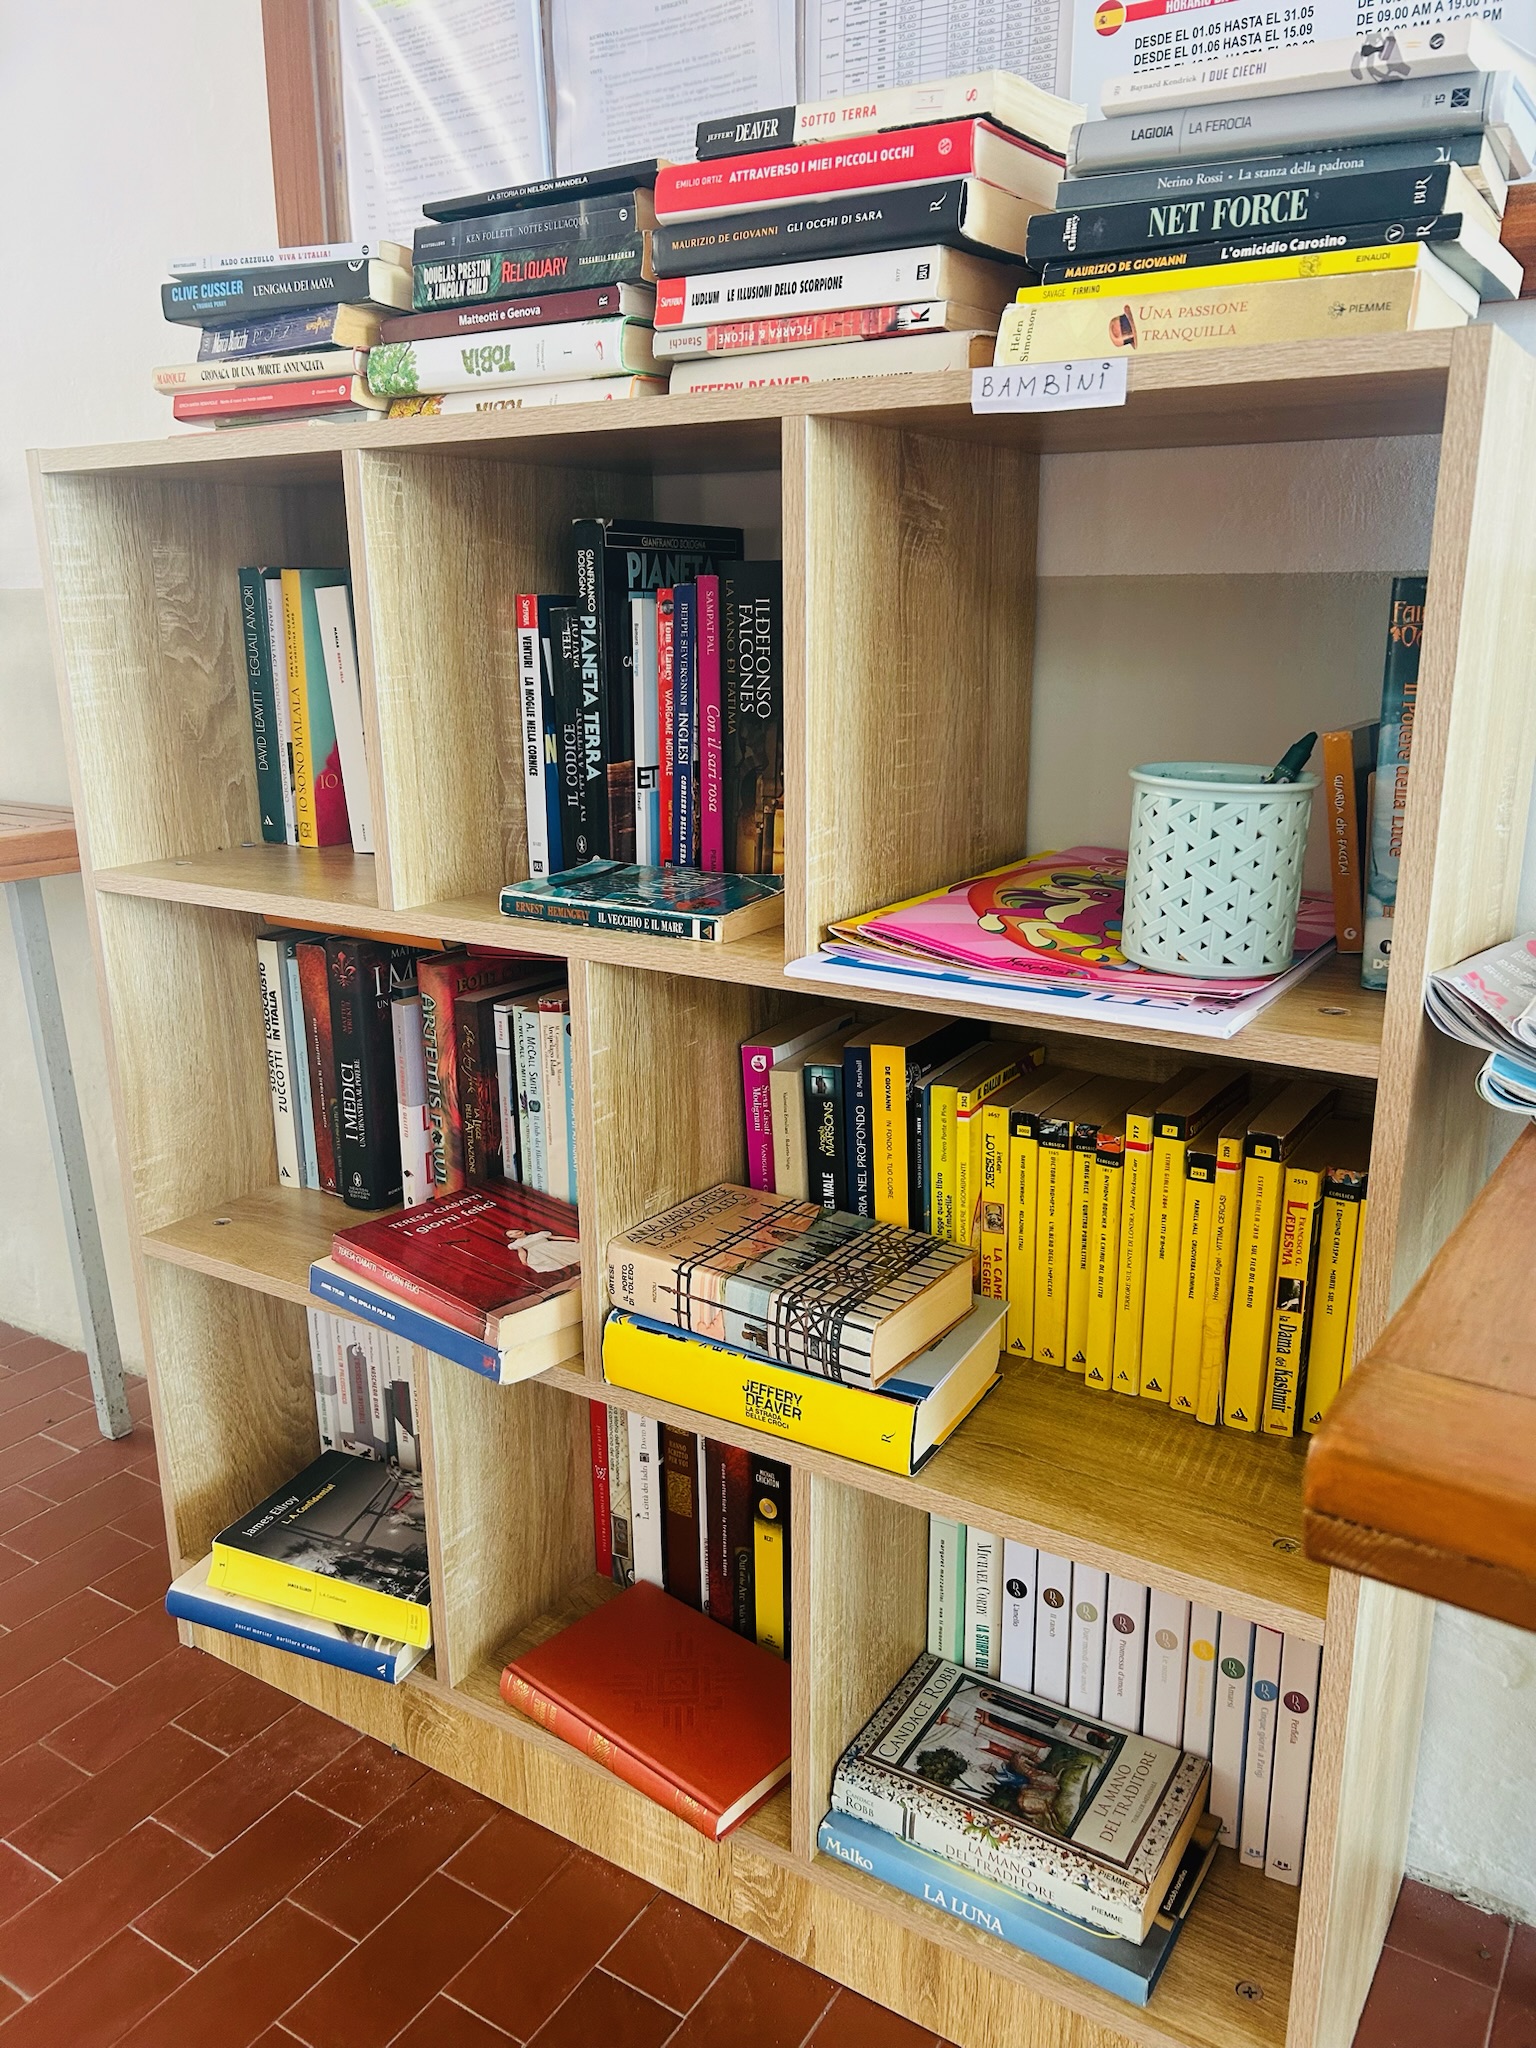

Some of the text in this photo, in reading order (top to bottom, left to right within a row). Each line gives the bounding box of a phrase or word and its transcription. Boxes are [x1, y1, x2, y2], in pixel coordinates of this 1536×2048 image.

[1134, 5, 1314, 49] DESDE EL 01.05 HASTA EL 31.05
[1134, 22, 1313, 66] DESDE EL 01.06 HASTA EL 15.09
[1209, 68, 1230, 82] DUE
[1232, 62, 1268, 78] CIECHI
[707, 104, 878, 143] JEFFERY DEAVER SOTTO TERRA
[1131, 115, 1252, 141] LAGIOIA LA FEROCIA
[676, 145, 914, 189] EMILIO ORTIZ ATTRAVERSO I MIEI PICCOLI OCCHI
[1157, 158, 1365, 189] Nerino Rossi La stanza della padrona
[671, 210, 883, 251] MAURIZIO DE GIOVANNI GLI OCCHI DI SARA
[1147, 189, 1310, 238] NET FORCE
[501, 257, 569, 283] RELIQUARY
[1064, 234, 1347, 278] MAURIZIO DE GIOVANNI L'omicidio Carosino
[171, 277, 334, 302] CLIVE CUSSLER L'ENIGMA DEI MAYA
[691, 276, 843, 306] LUDLUM LE ILLUSIONI DELLO SCORPIONE
[1178, 301, 1249, 318] PASSIONE
[458, 306, 541, 326] Matteotti e Genova
[1009, 320, 1024, 352] Helen
[1020, 309, 1037, 362] Simonson
[1142, 324, 1237, 341] TRANQUILLA
[577, 550, 586, 598] BOLOGNA
[586, 549, 596, 612] GIANFRANCO
[706, 591, 714, 635] SAMPAT
[244, 584, 269, 772] DAVID LEAVITT EGUALI AMORI
[739, 605, 754, 713] FALCONES
[755, 599, 771, 719] ILDEFONSO
[579, 615, 602, 781] PIANETA TERRA
[678, 603, 689, 764] BEPPE SEVERGNINI INGLESI
[706, 704, 720, 733] Con
[290, 686, 308, 813] IO SONO MALALA
[707, 737, 722, 750] il
[707, 752, 722, 780] sari
[708, 783, 718, 812] rosa
[1334, 774, 1344, 814] GUARDA
[1335, 817, 1344, 836] che
[515, 902, 684, 934] ERNEST HEMINGWAY IL VECCHIO E IL MARE
[259, 962, 272, 1040] L'OLOCAUSTO
[269, 991, 281, 1041] IN ITALIA
[268, 1050, 278, 1092] SUSAN
[275, 1051, 288, 1112] ZUCCOTTI
[341, 1062, 358, 1131] MEDICI
[823, 1101, 835, 1156] MARSONS
[856, 1106, 867, 1193] NEL PROFONDO
[985, 1133, 995, 1189] LOVESEY
[388, 1193, 483, 1231] TERESA CIABATTI
[415, 1214, 461, 1235] giorni
[461, 1200, 498, 1219] felici
[1282, 1200, 1308, 1266] LEDESMA
[623, 1293, 629, 1302] IL
[629, 1296, 635, 1306] DI
[1276, 1324, 1297, 1354] Dama
[741, 1379, 803, 1405] JEFFERY
[745, 1393, 802, 1421] DEAVER
[1271, 1368, 1293, 1413] Kashmir
[745, 1405, 782, 1421] LA STRADA
[745, 1410, 790, 1430] DELLE CROCI
[755, 1474, 780, 1489] CRICHTON
[759, 1469, 776, 1478] MICHAEL
[242, 1495, 300, 1537] James Ellroy
[976, 1543, 991, 1617] MICHAEL CORDY
[879, 1667, 957, 1757] CANDACE ROBB
[1094, 1764, 1131, 1817] LA MANO
[1100, 1751, 1157, 1843] DEL TRADITORE
[826, 1837, 873, 1871] Malko
[924, 1884, 1004, 1936] LA LUNA
